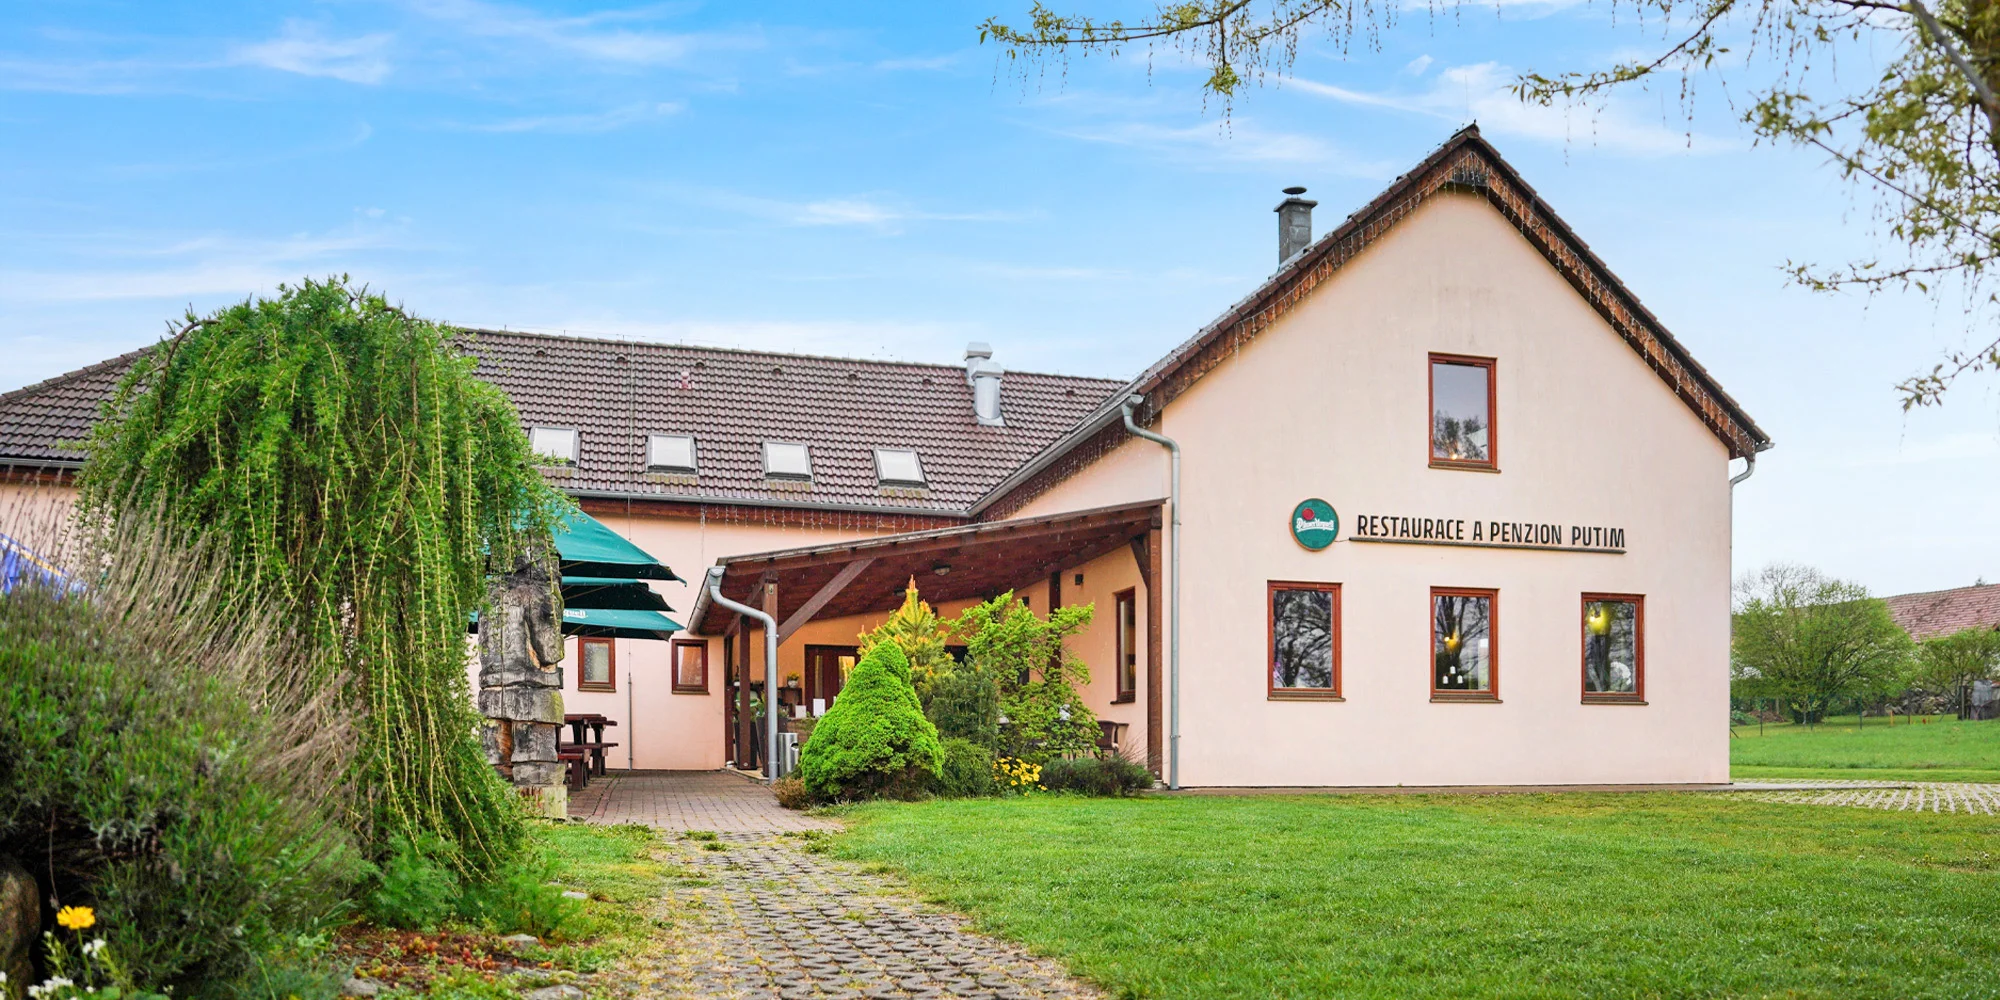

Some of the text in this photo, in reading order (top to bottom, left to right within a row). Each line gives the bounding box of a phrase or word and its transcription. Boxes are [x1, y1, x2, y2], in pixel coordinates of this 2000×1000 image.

[1357, 514, 1625, 548] RESTAURACE A PENZION PUTIM
